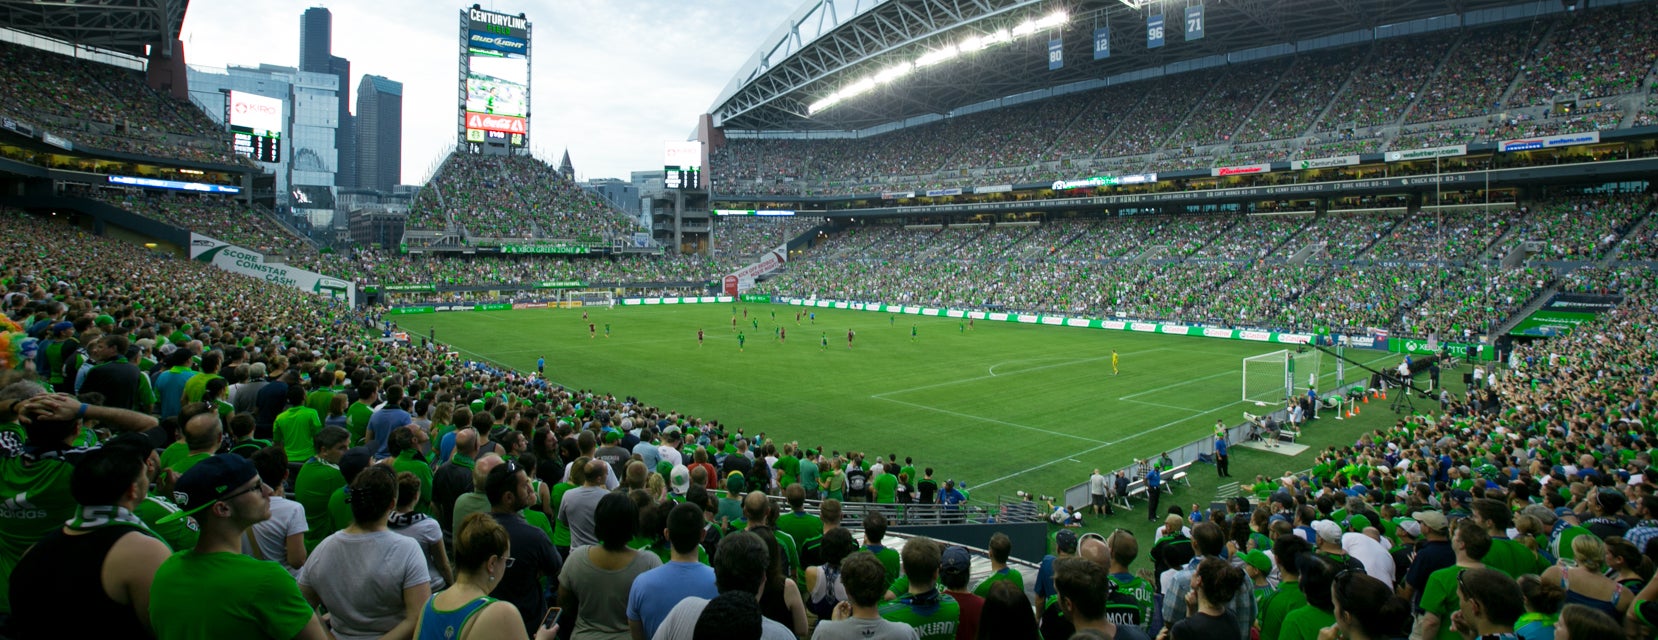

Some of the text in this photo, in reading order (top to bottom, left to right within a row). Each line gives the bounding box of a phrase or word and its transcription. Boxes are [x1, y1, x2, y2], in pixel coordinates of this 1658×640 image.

[471, 9, 526, 30] CENTURYLINK
[1187, 18, 1201, 33] 71
[487, 22, 511, 36] FIELD
[1148, 26, 1163, 41] 96
[471, 34, 524, 49] BUD LIGHT
[1096, 38, 1107, 52] 12
[1050, 49, 1062, 63] 80
[223, 248, 258, 263] SCORE
[236, 259, 287, 277] COINSTAR
[265, 273, 297, 287] CASH!
[1246, 332, 1269, 341] Castrol
